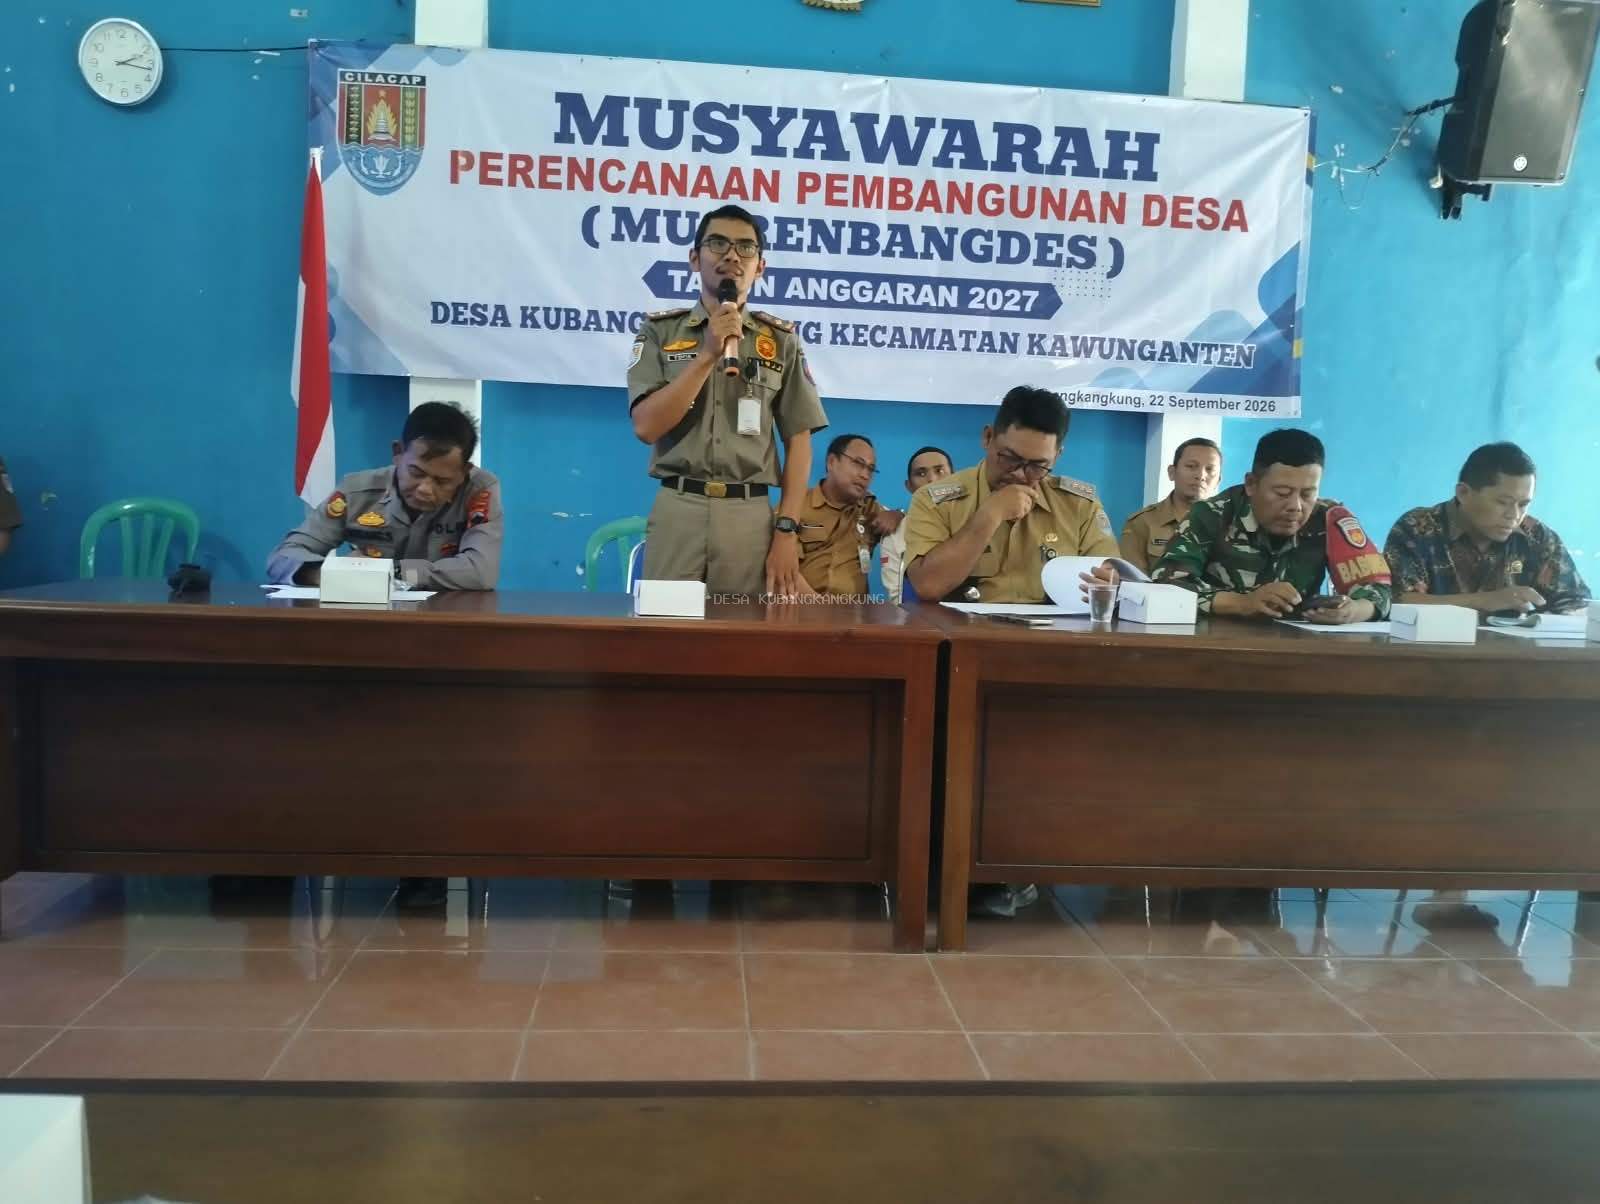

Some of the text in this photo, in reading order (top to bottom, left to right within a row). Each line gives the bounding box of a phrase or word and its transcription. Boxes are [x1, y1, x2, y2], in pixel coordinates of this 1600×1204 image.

[344, 72, 422, 85] CILACAP
[554, 91, 1161, 183] MUSYAWARAH
[449, 150, 1250, 233] PERENCANAAN PEMBANGUNAN DESA
[581, 204, 1125, 280] (MURENBANGDES)
[667, 269, 1040, 313] TAN ANGGARAN 2027
[430, 301, 512, 328] DESA
[830, 323, 1020, 354] KECAMATAN
[1026, 333, 1256, 369] KAWUNGANTEN
[1056, 389, 1277, 412] ngkangkung, 22 September 2026
